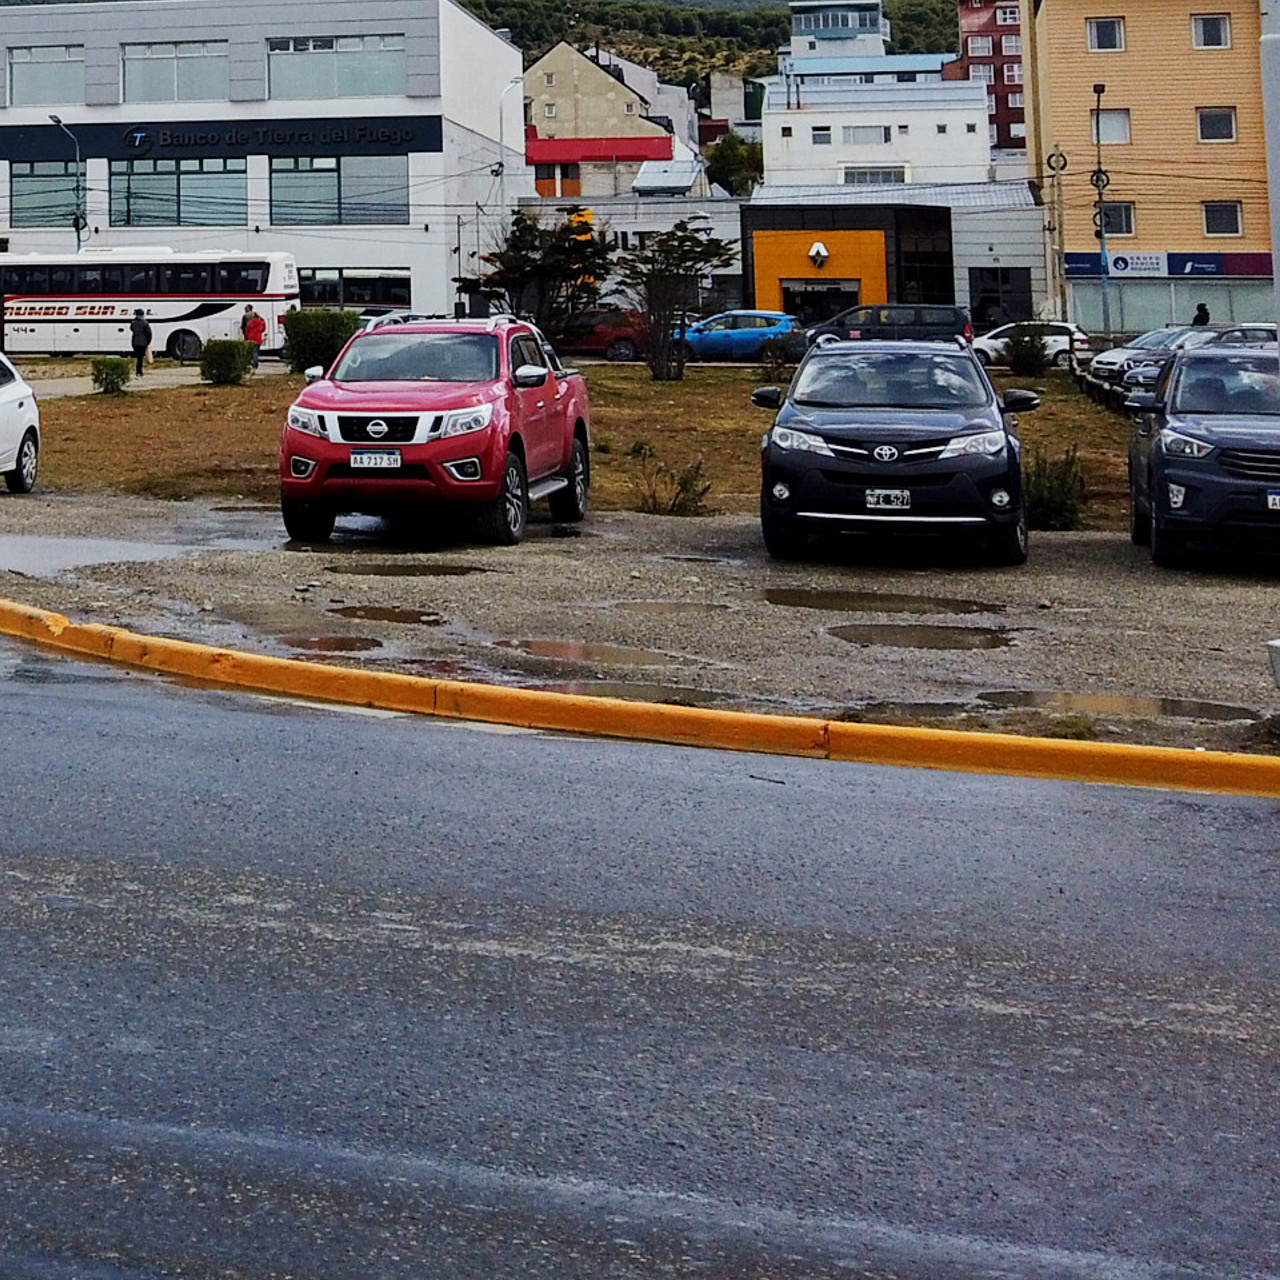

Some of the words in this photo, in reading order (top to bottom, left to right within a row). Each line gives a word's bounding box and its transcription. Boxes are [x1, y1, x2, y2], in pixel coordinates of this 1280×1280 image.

[159, 129, 220, 147] Banco
[225, 127, 249, 145] de
[254, 127, 313, 144] Tierra
[319, 126, 349, 142] del
[355, 126, 414, 144] Fuego
[12, 326, 28, 335] 44
[352, 456, 365, 466] AA
[366, 456, 384, 466] 717
[386, 456, 399, 467] SH
[890, 494, 908, 506] 527
